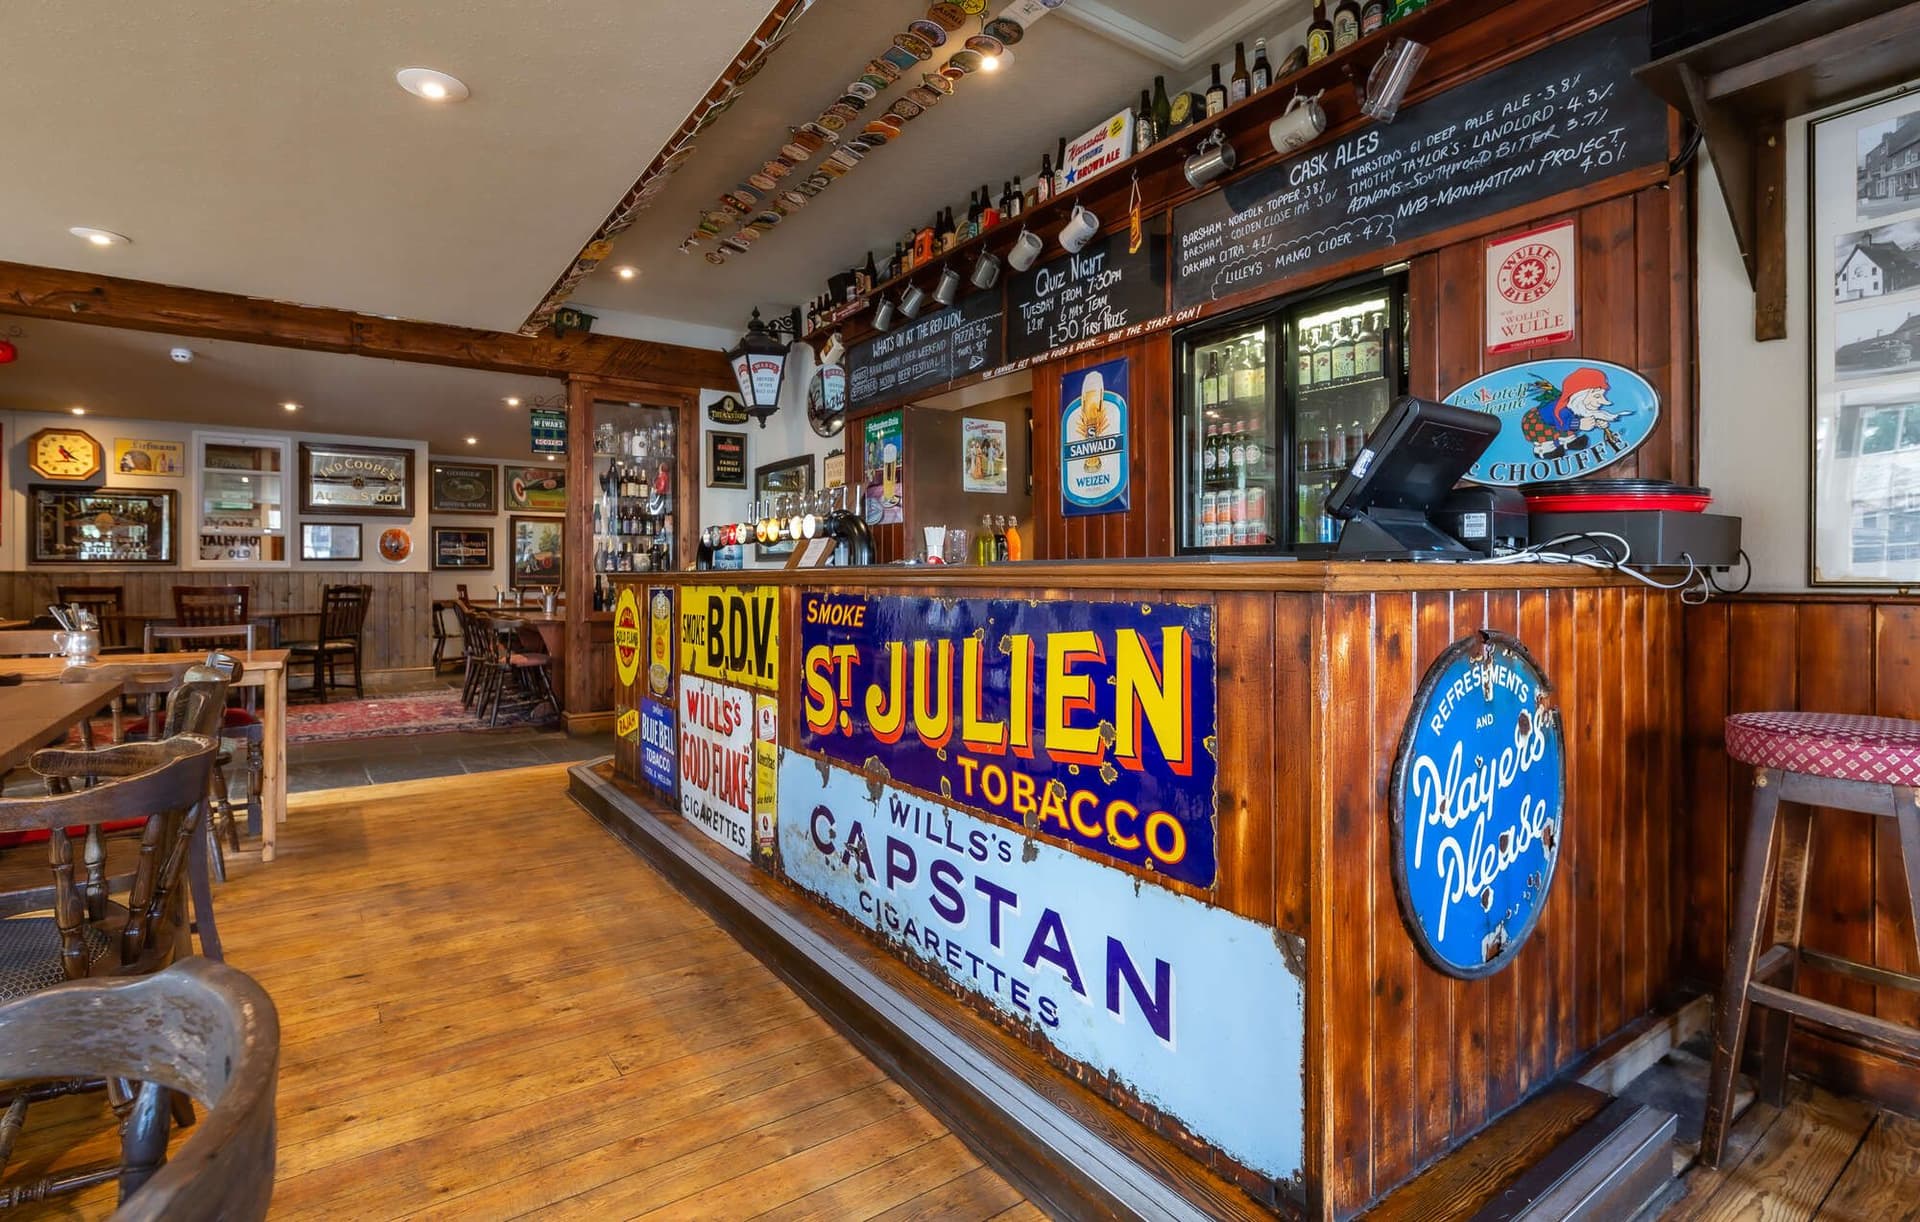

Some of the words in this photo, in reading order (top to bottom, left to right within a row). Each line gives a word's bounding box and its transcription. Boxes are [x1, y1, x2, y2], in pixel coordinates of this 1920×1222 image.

[1426, 125, 1457, 147] DEEP
[1465, 110, 1494, 131] PALE
[1502, 94, 1532, 116] ALE
[1077, 157, 1104, 180] BROWN
[1105, 148, 1120, 167] ALE
[1290, 152, 1328, 185] CASK
[1334, 130, 1379, 169] ALES
[1347, 166, 1396, 196] TIMOTHY
[1401, 142, 1460, 175] TAYLOR'S
[1473, 105, 1554, 148] LANDLORD
[1182, 221, 1222, 248] BARSHAM
[1228, 206, 1264, 227] NORFOLK
[1267, 190, 1300, 211] TOPPER
[1183, 235, 1223, 261] BARSHAM
[1231, 219, 1262, 240] GOLDEN
[1264, 208, 1291, 228] CLOSE
[1294, 200, 1310, 216] IPA
[1182, 256, 1216, 277] OAKHAM
[1219, 243, 1245, 262] CITRA
[1225, 260, 1264, 284] LILLEY'S
[1274, 246, 1311, 269] MANGO
[1318, 231, 1352, 253] CIDER
[1503, 245, 1555, 271] WULLE
[1061, 287, 1083, 305] FROM
[1504, 278, 1556, 303] BIERE
[1060, 305, 1066, 322] 6
[1501, 314, 1565, 337] WULLE
[1505, 308, 1550, 324] WOLLEN
[895, 332, 905, 348] ON
[906, 329, 914, 344] AT
[916, 323, 929, 341] THE
[929, 317, 943, 336] RED
[954, 327, 974, 346] PIZZA
[1048, 319, 1079, 348] £50
[1051, 346, 1069, 358] FOOD
[1108, 330, 1122, 342] BUT
[1126, 324, 1142, 337] THE
[1145, 315, 1173, 332] STAFF
[1176, 304, 1202, 322] CAN!
[1070, 438, 1117, 457] SANWALD
[1489, 430, 1629, 481] CHOUFFE
[319, 462, 343, 478] IND
[1076, 473, 1111, 488] WEIZEN
[228, 549, 251, 559] OLD
[807, 599, 866, 628] SMOKE
[683, 614, 705, 647] SMOKE
[707, 595, 774, 680] B.D.V.
[865, 625, 1193, 776] JULIEN
[1430, 664, 1530, 737] REFRESHMENTS
[642, 713, 658, 746] BLUE
[659, 719, 675, 756] BELL
[1475, 712, 1495, 730] AND
[646, 747, 671, 773] TOBACCO
[956, 755, 1187, 866] TOBACCO
[889, 797, 1013, 864] WILLS'S
[1437, 794, 1547, 942] Please
[809, 803, 1175, 1046] CAPSTAN
[858, 891, 1061, 1028] CIGARETTES
